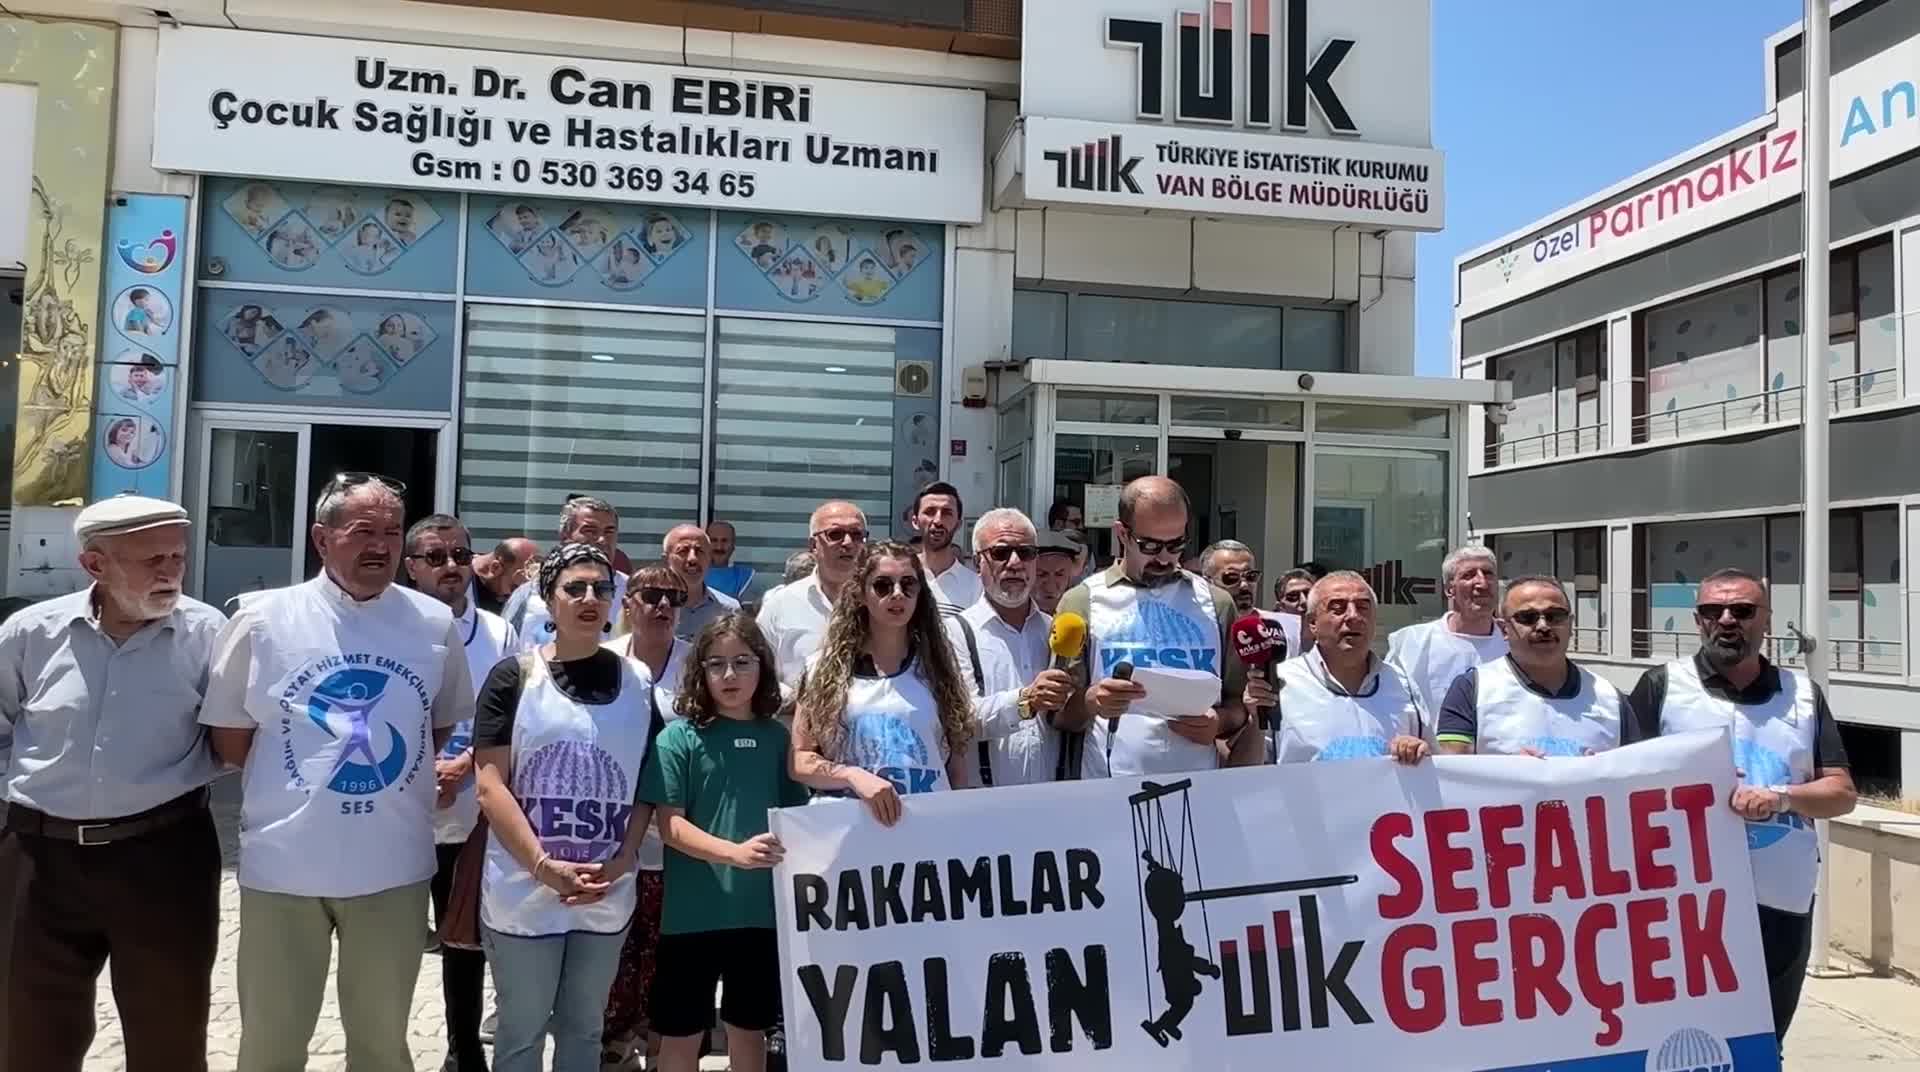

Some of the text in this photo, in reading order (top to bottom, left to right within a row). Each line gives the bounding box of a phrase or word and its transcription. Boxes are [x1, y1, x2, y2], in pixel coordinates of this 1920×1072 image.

[357, 57, 458, 96] Uzm.
[473, 67, 527, 101] Dr.
[549, 66, 653, 112] Can
[210, 89, 937, 172] Çocuk Sağlığı ve Hastalıkları Uzmanı
[411, 151, 482, 181] Gsm
[512, 158, 531, 183] 0
[541, 160, 597, 188] 530
[607, 165, 663, 193] 369
[672, 169, 709, 196] 34
[719, 173, 756, 199] 65
[1155, 173, 1429, 214] VAN BÖLGE MÜDÜRLÜĞÜ
[1345, 158, 1429, 183] KURUMU
[1533, 222, 1580, 264] Özel
[316, 652, 372, 673] HİZMET
[340, 778, 377, 793] 1996
[340, 800, 375, 815] SES
[1369, 783, 1716, 920] SEFALET
[792, 848, 1106, 933] RAKAMLAR
[1380, 888, 1740, 1047] GERÇEK
[797, 943, 1113, 1066] YALAN
